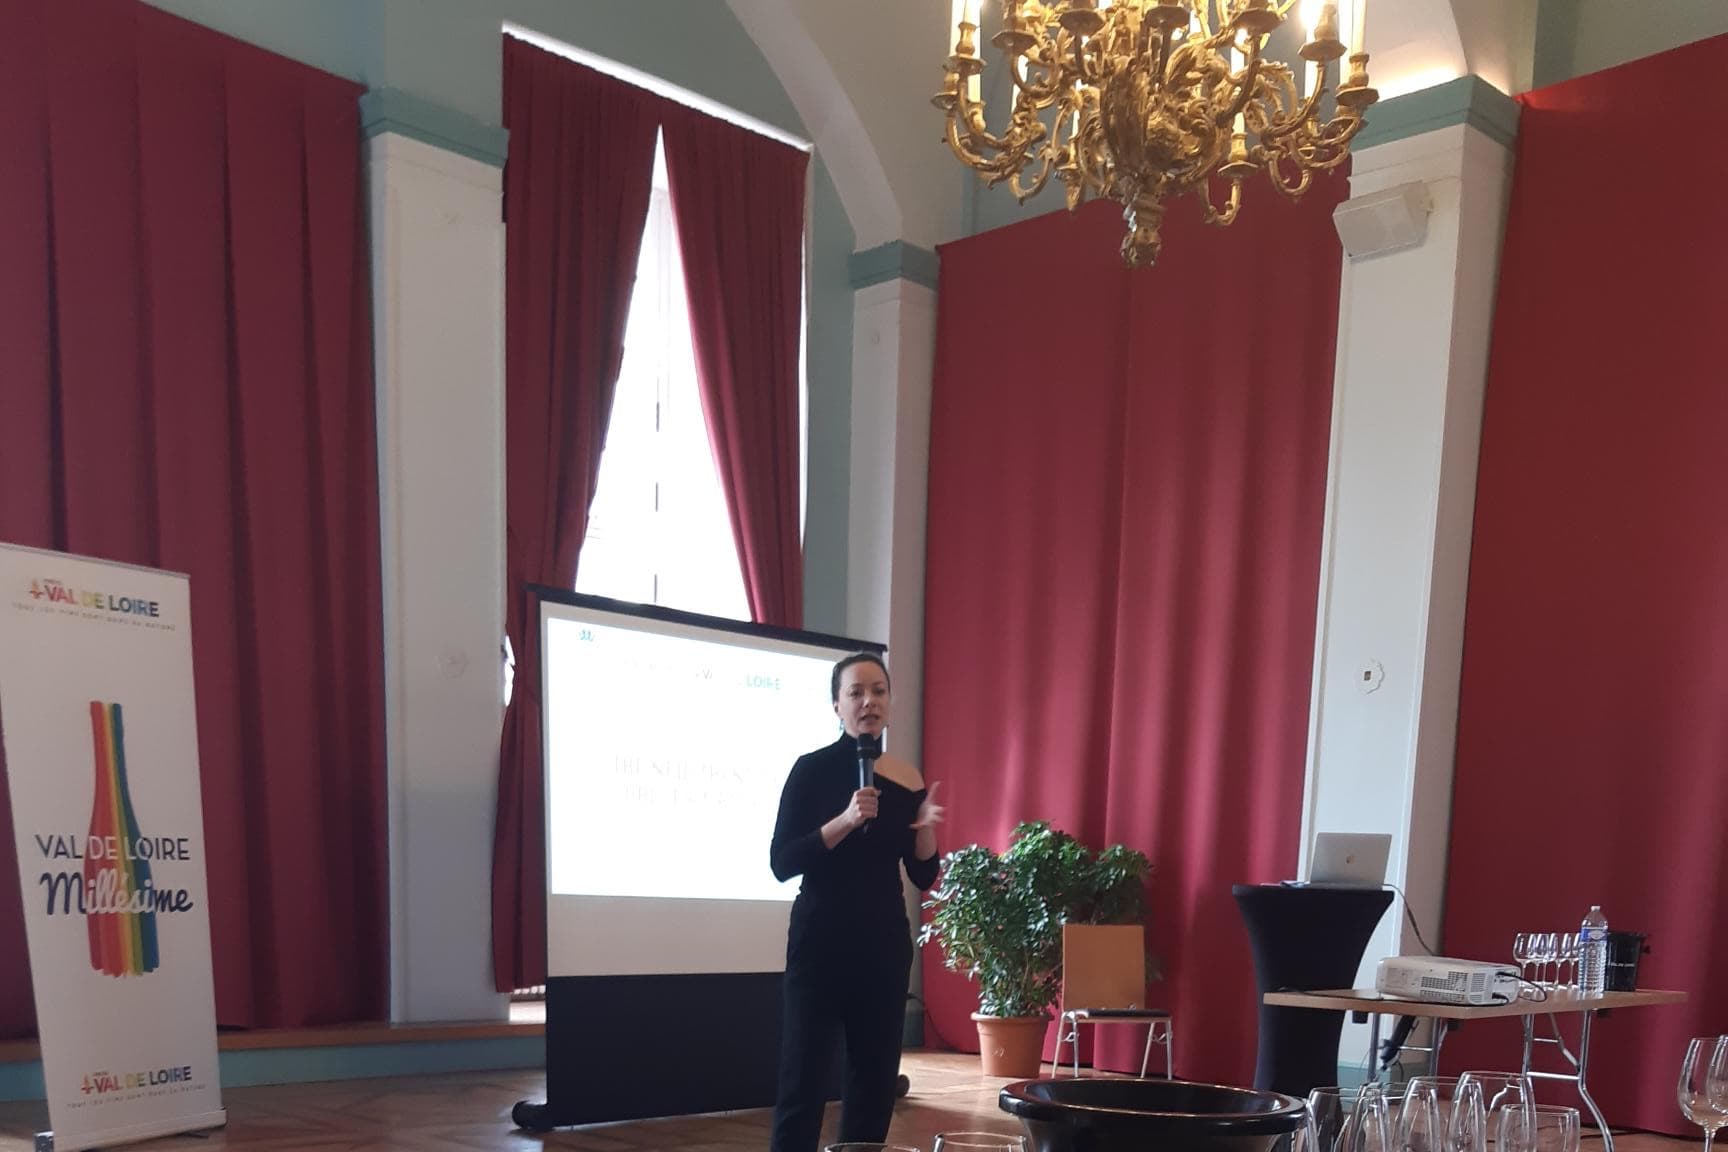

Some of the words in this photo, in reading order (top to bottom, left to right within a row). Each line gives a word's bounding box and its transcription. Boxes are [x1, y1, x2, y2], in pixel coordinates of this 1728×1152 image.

[44, 583, 77, 605] VAL
[108, 594, 160, 618] LOIRE
[35, 834, 83, 860] VAL
[88, 836, 119, 861] DE
[124, 836, 191, 861] LOIRE
[93, 1076, 122, 1094] VAL
[149, 1065, 193, 1086] LOIRE
